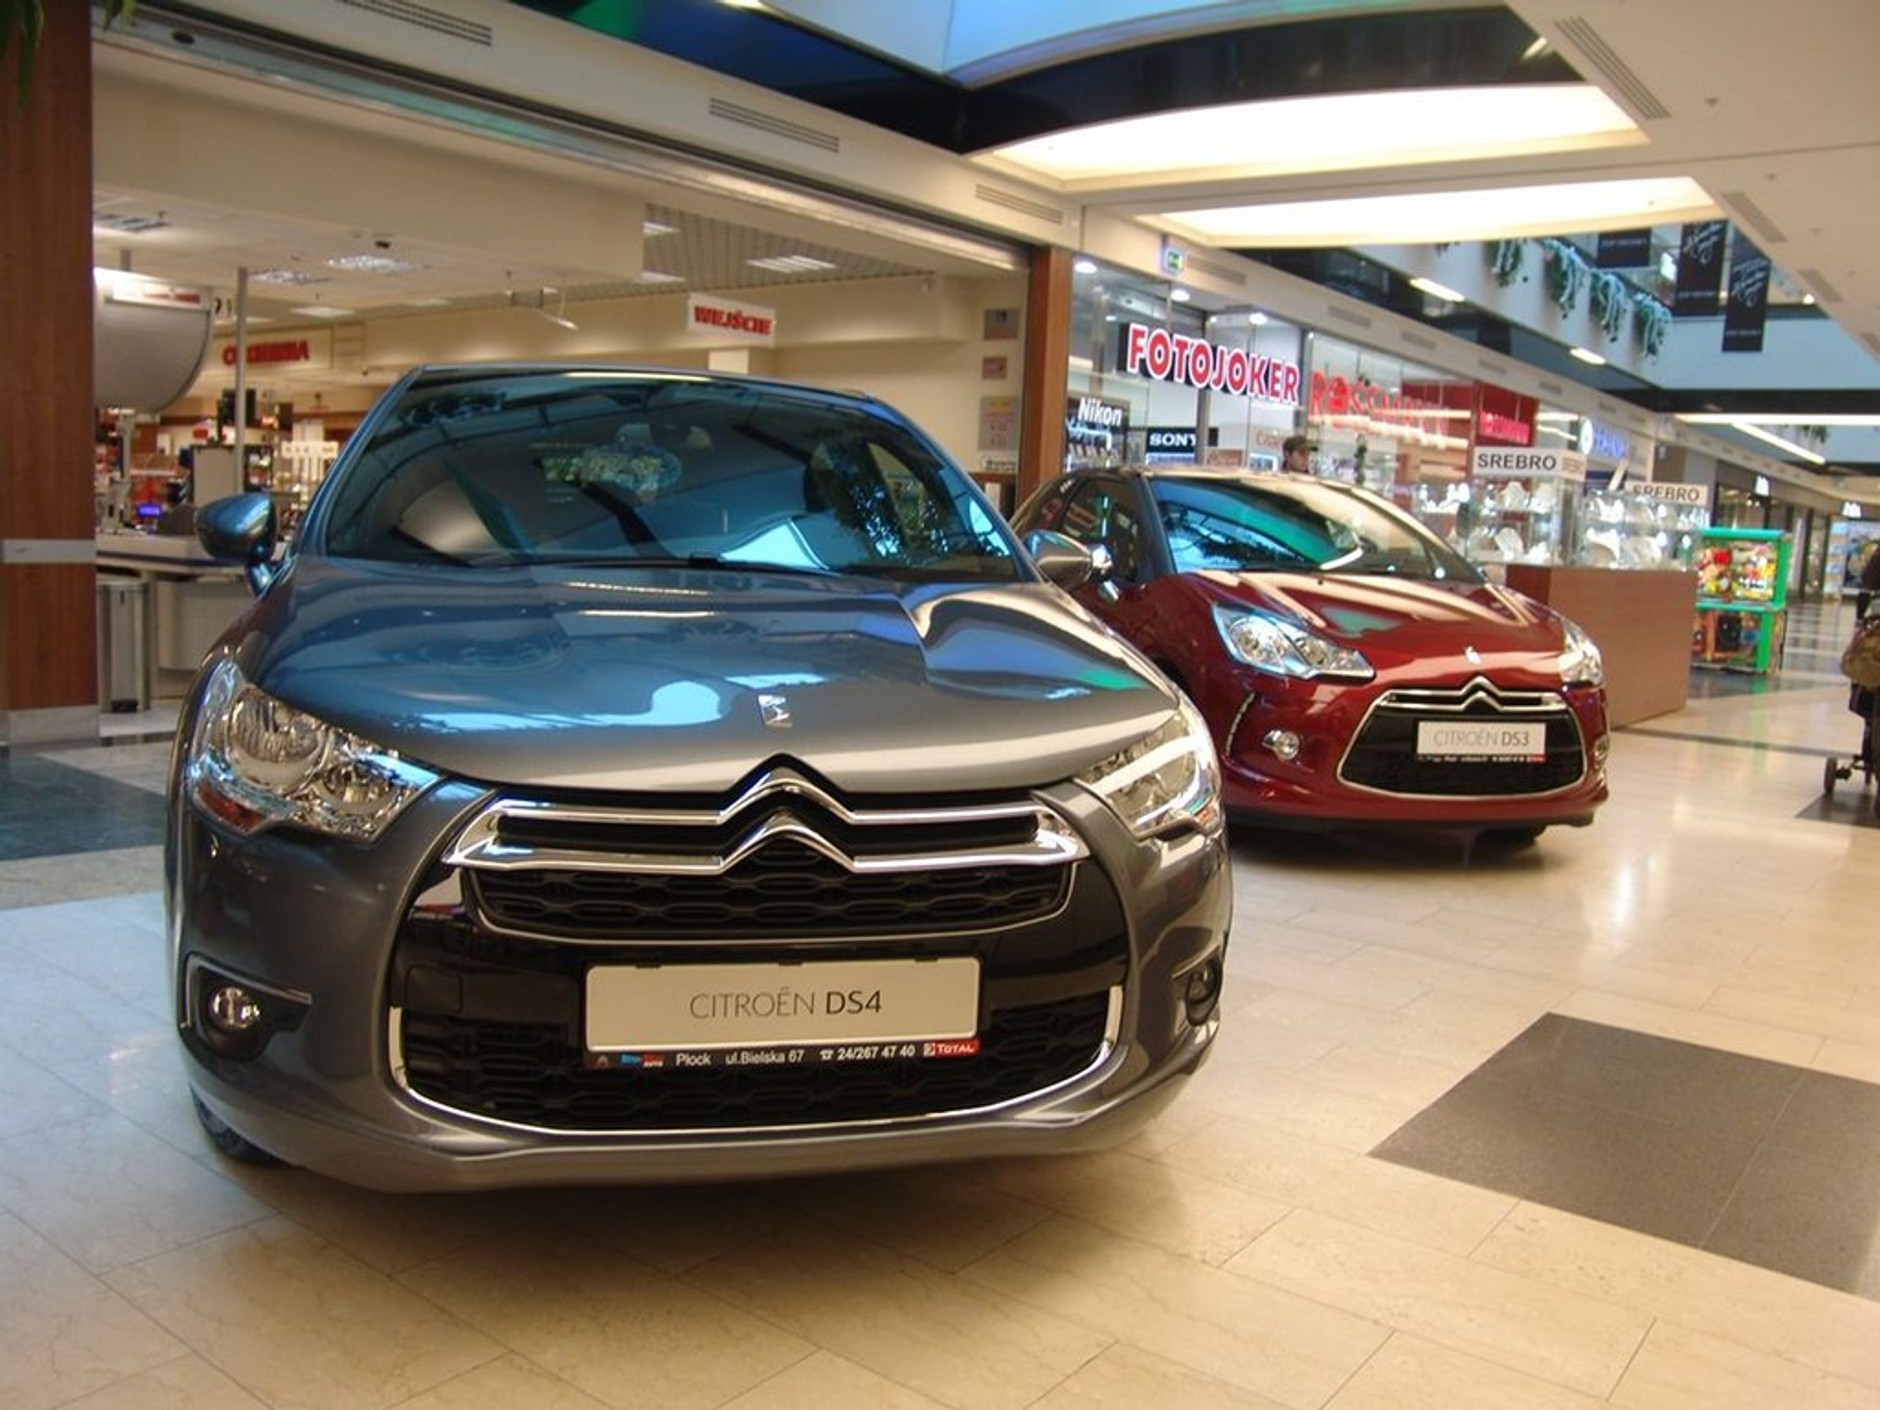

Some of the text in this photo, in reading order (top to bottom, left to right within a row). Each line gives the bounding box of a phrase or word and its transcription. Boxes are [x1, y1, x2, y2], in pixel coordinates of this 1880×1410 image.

[1127, 323, 1300, 405] FOTOJOKER
[1078, 397, 1122, 426] Nikon
[1477, 453, 1557, 472] SREBRO
[1501, 731, 1529, 747] DS3
[690, 986, 882, 1020] CITROËN DS4
[881, 1045, 897, 1058] 47
[899, 1045, 916, 1057] 40
[937, 1043, 976, 1054] TOTAL
